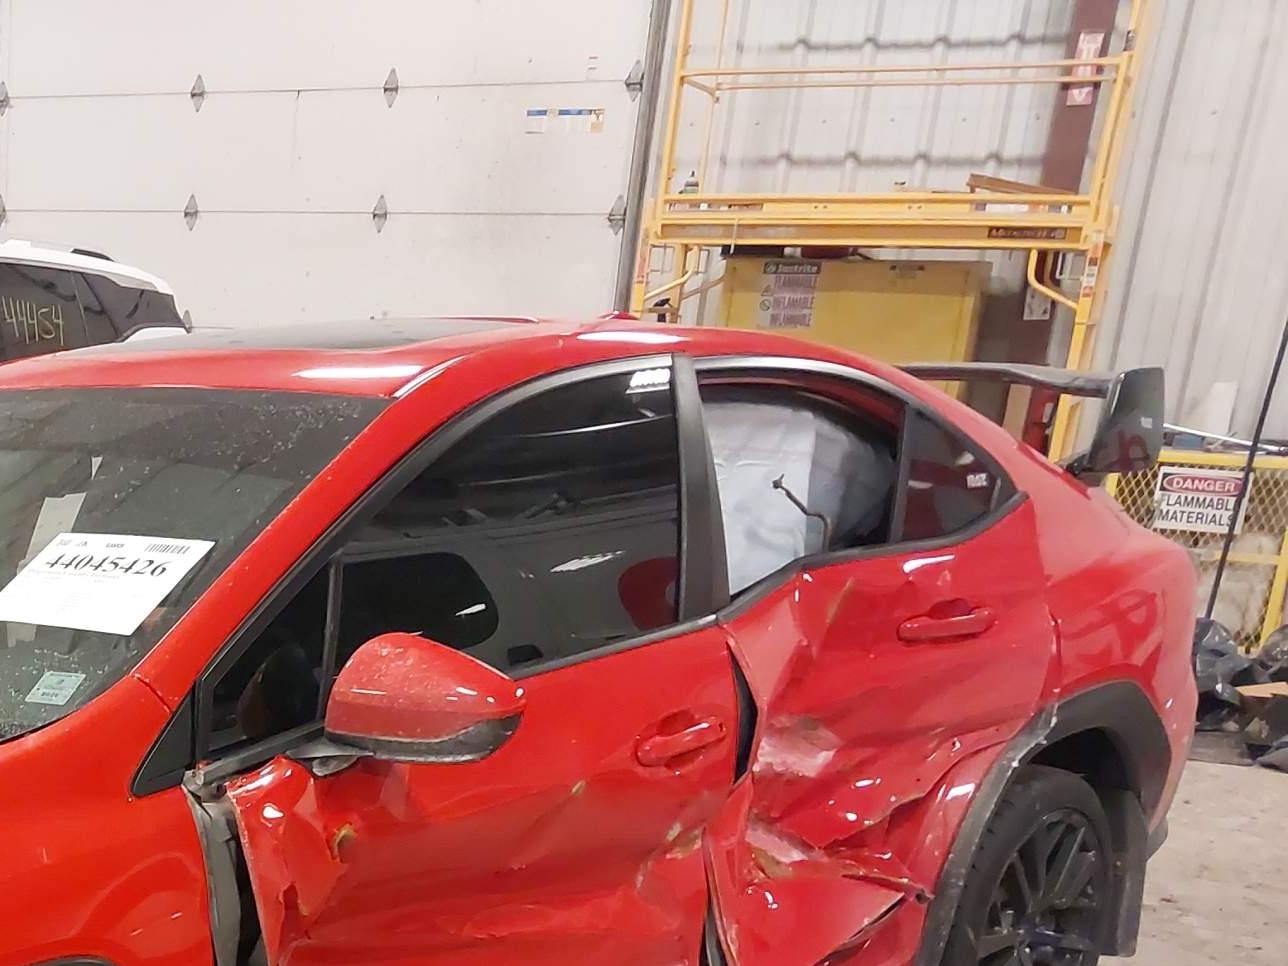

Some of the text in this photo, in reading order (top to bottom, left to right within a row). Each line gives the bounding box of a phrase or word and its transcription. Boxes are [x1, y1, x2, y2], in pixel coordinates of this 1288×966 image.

[1, 295, 65, 346] 44454
[1172, 477, 1236, 493] DANGER
[1159, 492, 1233, 512] FLAMMABL
[45, 553, 173, 577] 44045426
